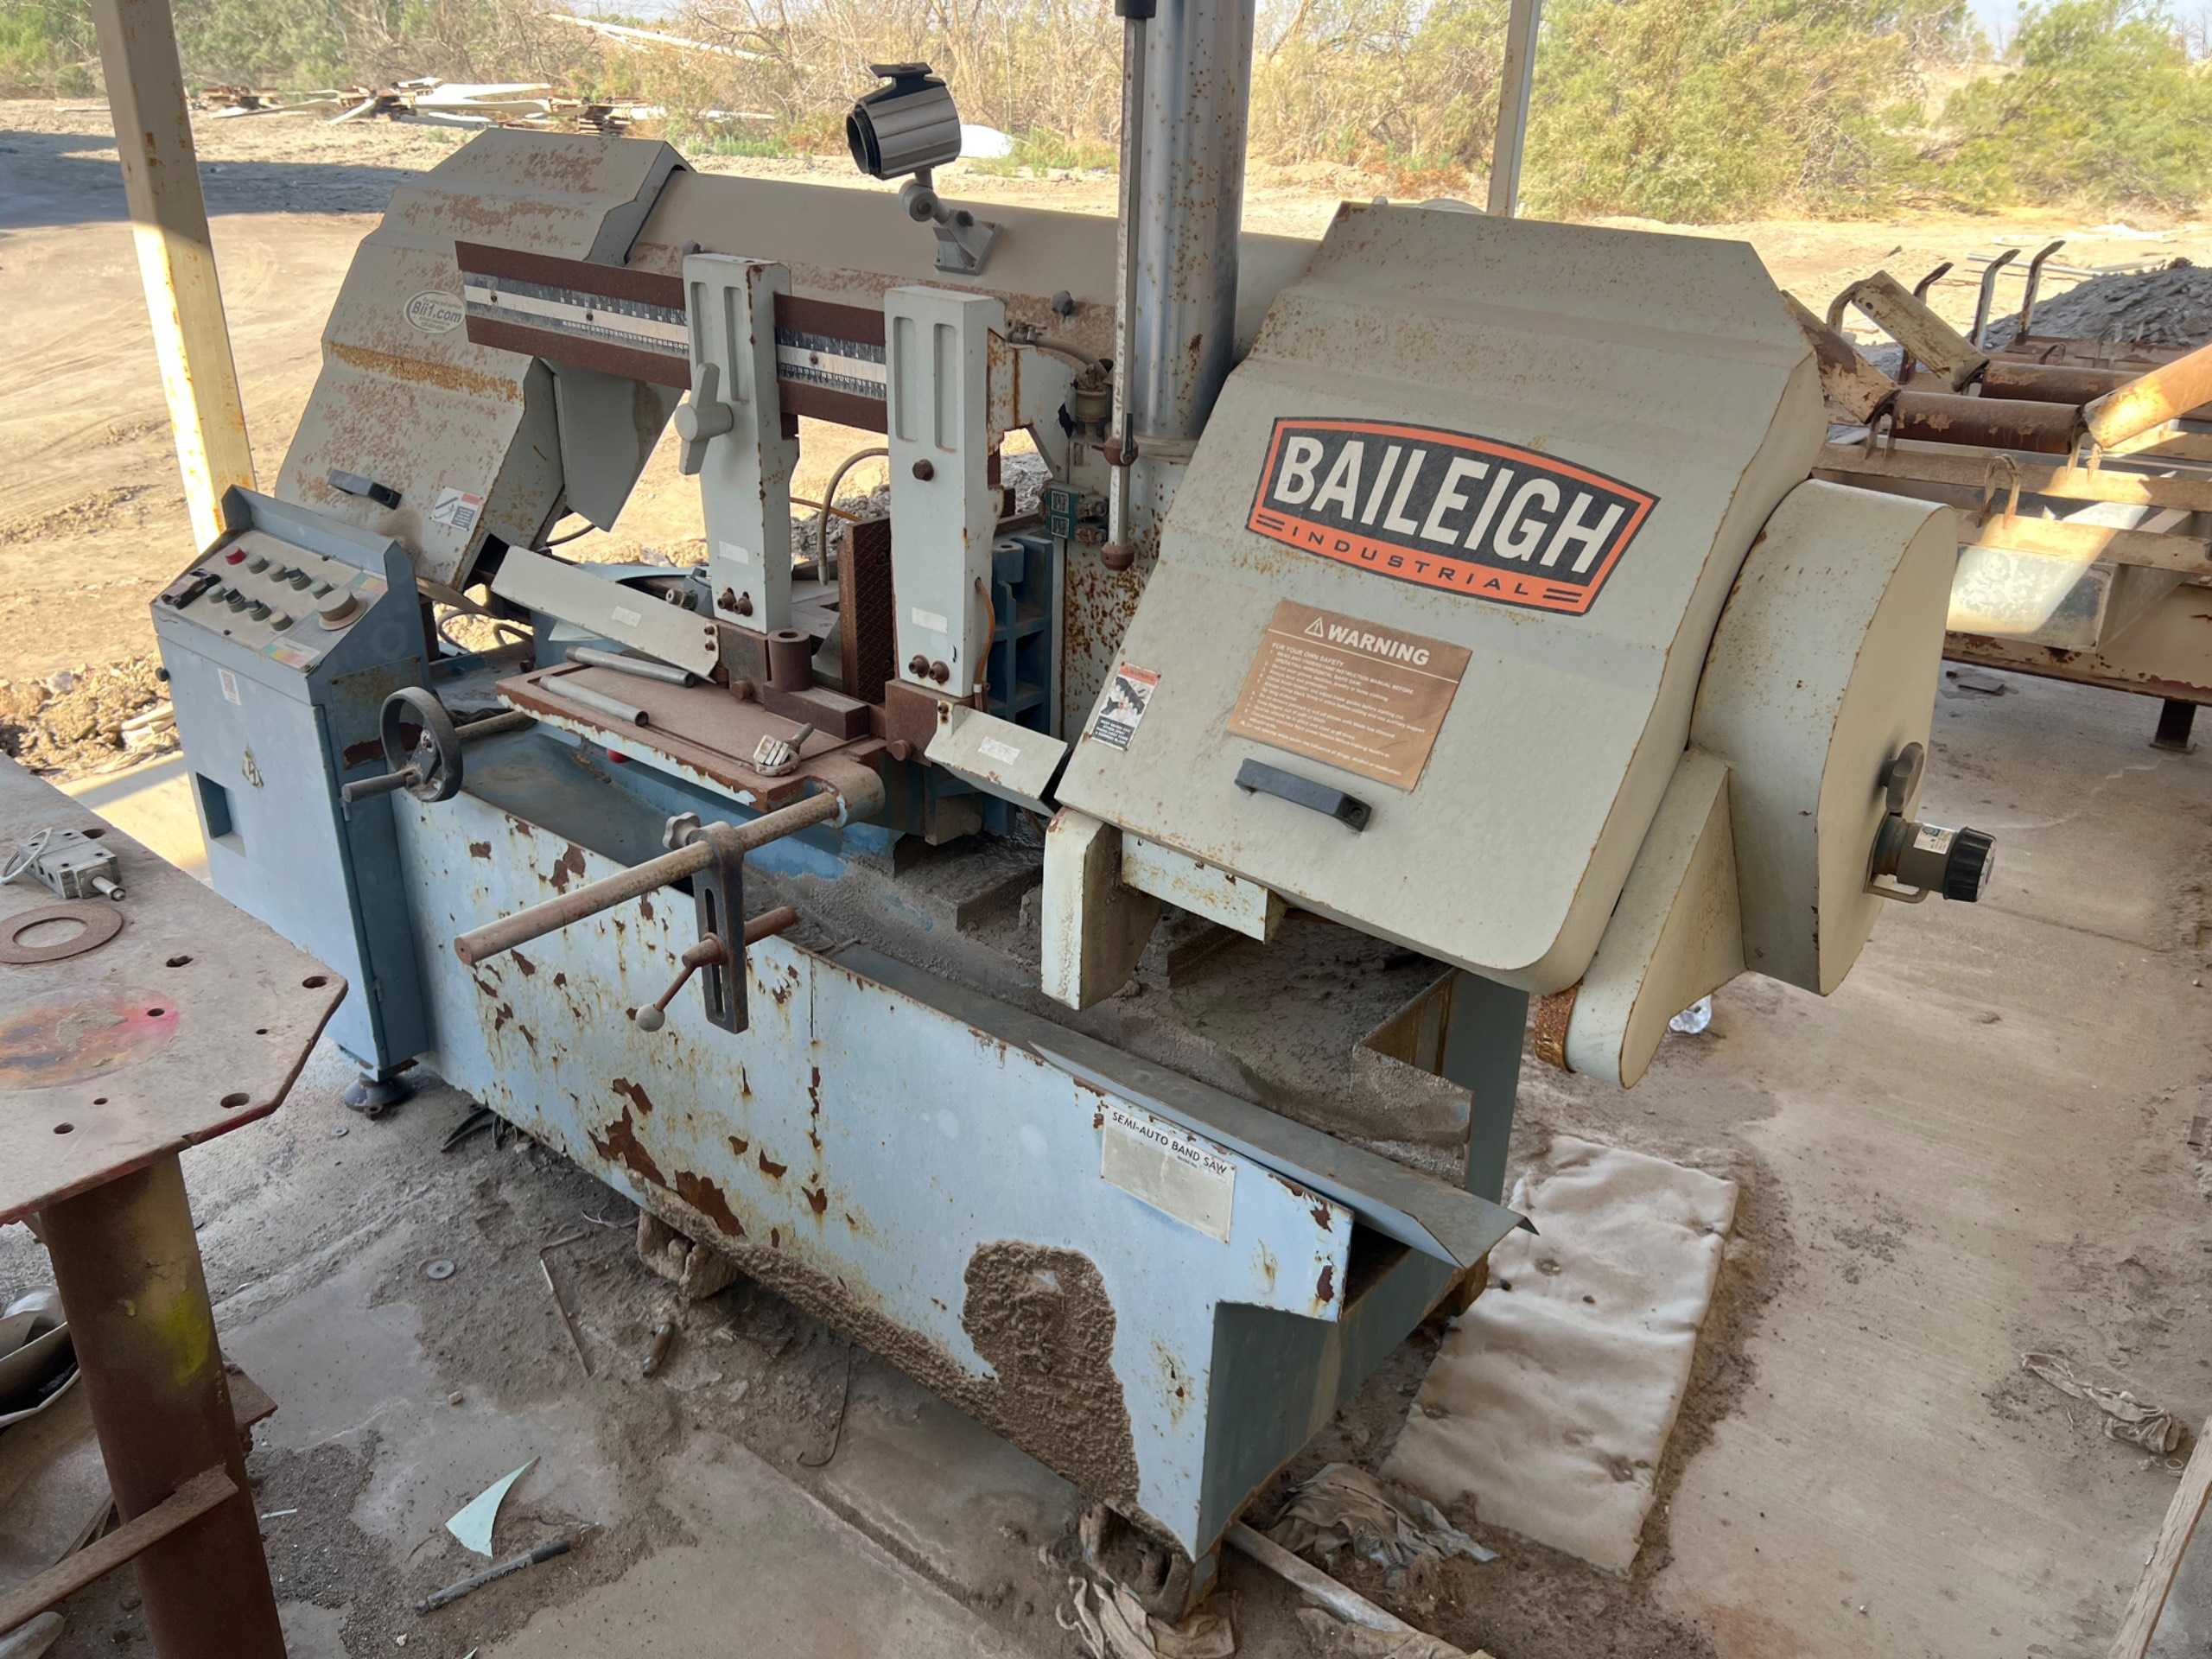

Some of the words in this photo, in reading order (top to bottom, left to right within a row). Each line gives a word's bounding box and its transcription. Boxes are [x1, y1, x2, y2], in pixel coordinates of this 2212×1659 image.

[1273, 435, 1625, 575] BAILEIGH
[1292, 524, 1529, 596] INDUSTRIAL
[1319, 656, 1344, 667] SAFETY
[1327, 623, 1431, 666] WARNING
[1112, 1111, 1168, 1146] SEMI-AUTO
[1171, 1140, 1200, 1162] BAND
[1203, 1156, 1228, 1175] SAW
